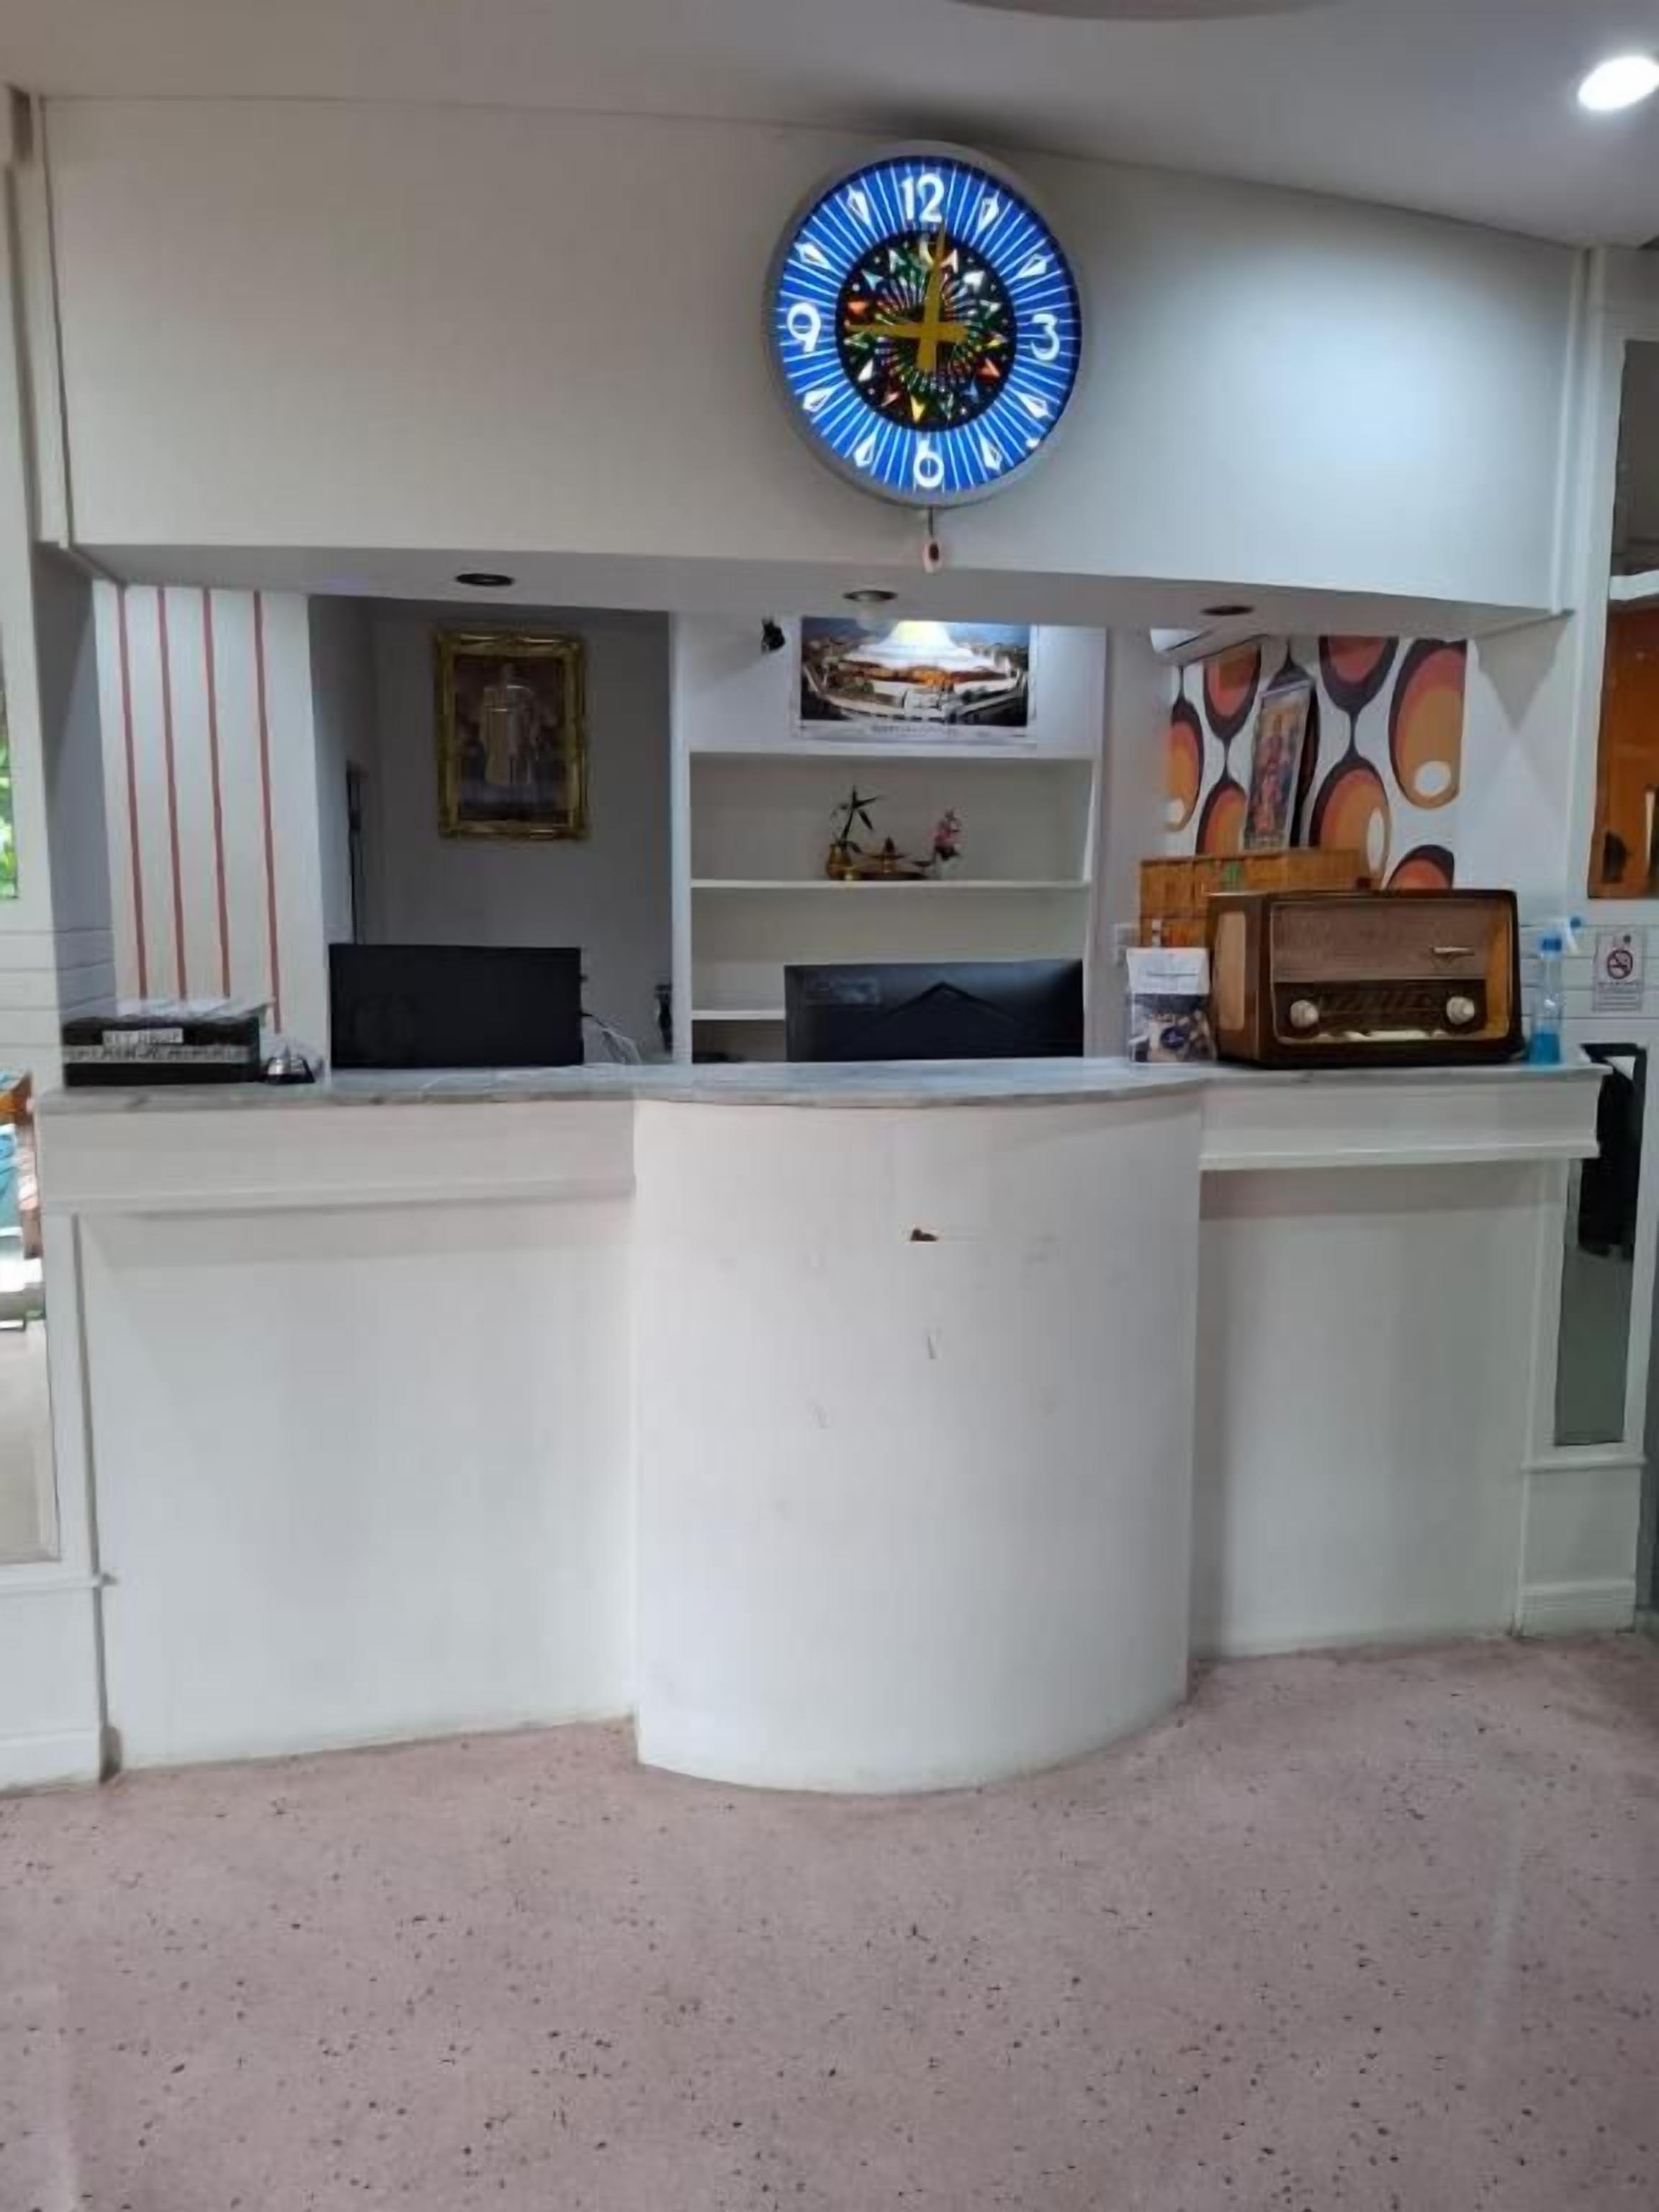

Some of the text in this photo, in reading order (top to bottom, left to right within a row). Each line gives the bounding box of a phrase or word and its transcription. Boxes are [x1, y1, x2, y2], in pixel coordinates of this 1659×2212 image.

[901, 174, 945, 222] 12
[787, 302, 822, 353] 9
[1030, 313, 1059, 360] 3
[913, 439, 945, 488] 6
